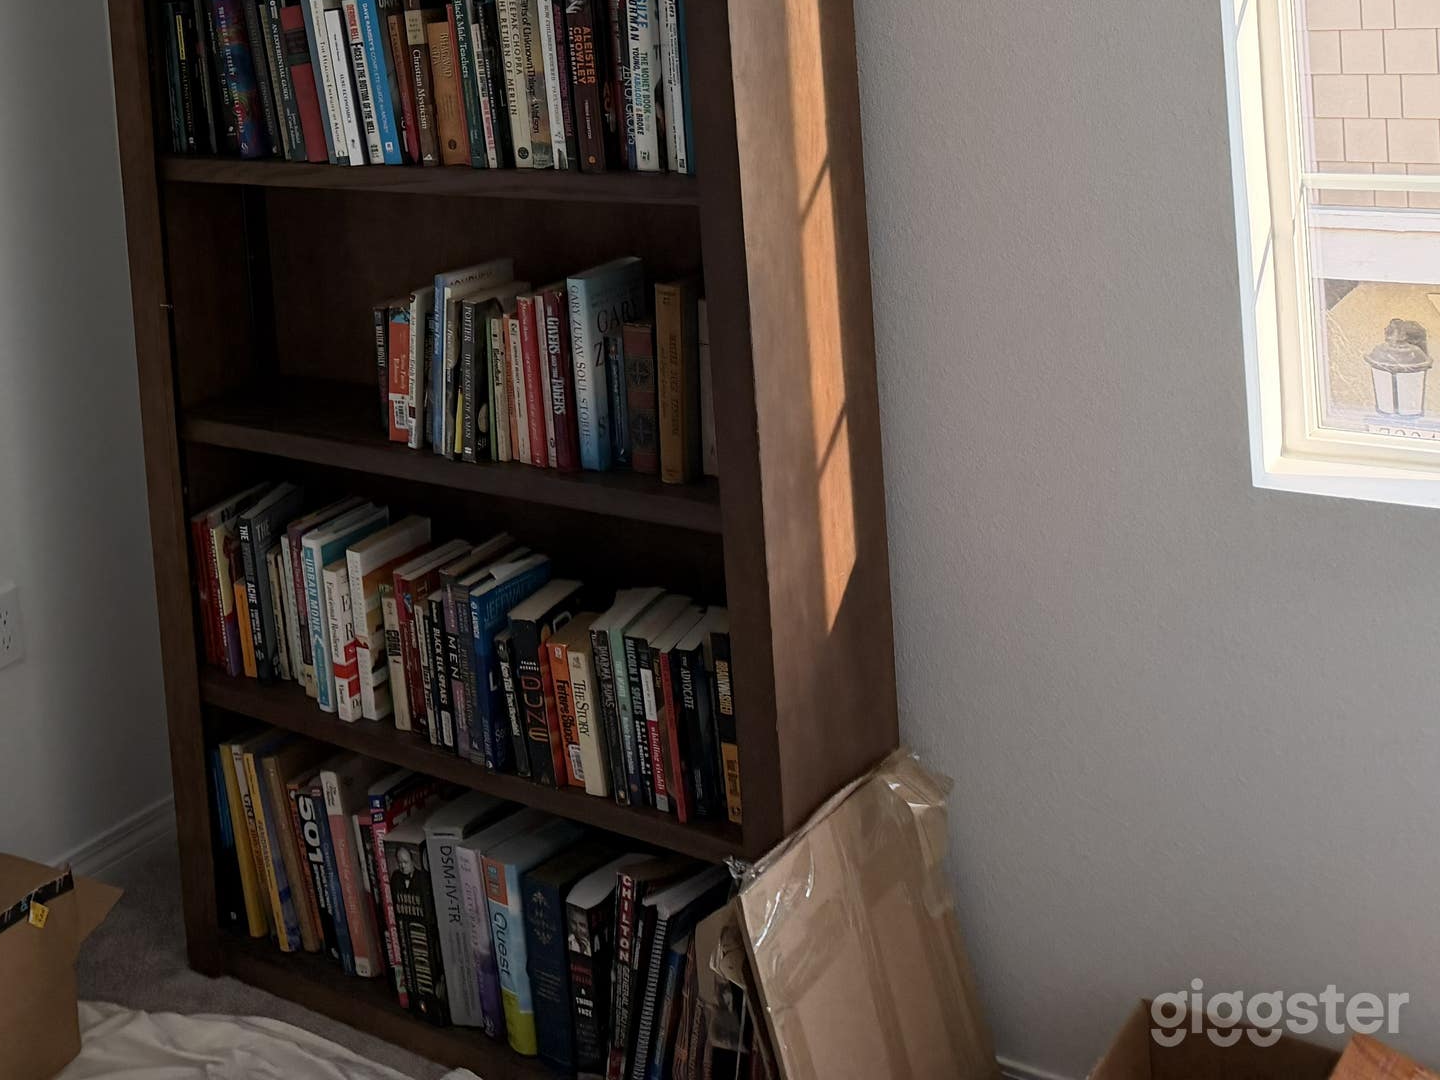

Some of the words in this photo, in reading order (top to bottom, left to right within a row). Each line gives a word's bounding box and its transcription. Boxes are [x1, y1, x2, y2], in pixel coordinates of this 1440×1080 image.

[346, 4, 357, 26] DERRICK
[456, 21, 466, 41] Male
[628, 0, 640, 42] ORMAN
[350, 28, 359, 40] BELL
[500, 18, 509, 57] RETURN
[522, 27, 534, 69] Unknown
[272, 34, 286, 78] EXPERIENTIAL
[412, 49, 422, 86] Christian
[459, 43, 470, 79] Teachers
[505, 61, 513, 75] OF
[511, 34, 522, 75] CHOPRA
[573, 26, 587, 85] CROWLEY
[581, 26, 596, 84] ALEISTER
[631, 47, 641, 72] YOUNG,
[640, 52, 648, 66] THE
[357, 69, 365, 79] THE
[633, 73, 643, 107] FABULOUS
[641, 67, 650, 93] MONEY
[364, 110, 372, 119] THE
[415, 88, 429, 129] Mysticism
[507, 79, 518, 116] MERLIN
[643, 94, 652, 114] BOOK
[367, 121, 375, 135] WELL
[636, 113, 644, 136] BROKE
[569, 285, 581, 315] GARY
[463, 306, 473, 343] POITIER
[546, 317, 561, 354] GIVERS
[572, 320, 584, 358] ZUKAV
[576, 362, 588, 392] SOUL
[551, 378, 567, 416] TAKERS
[464, 420, 472, 439] MAN
[581, 398, 592, 450] STORIES
[239, 525, 249, 542] THE
[247, 582, 258, 606] ACHE
[305, 559, 316, 598] URBAN
[310, 600, 321, 633] MONK
[432, 627, 443, 655] BLACK
[447, 635, 460, 680] MEN
[435, 656, 445, 672] ELK
[598, 645, 611, 681] DHARMA
[625, 639, 637, 674] MALCOLM
[631, 686, 644, 715] SPEAKS
[437, 673, 448, 705] SPEAKS
[555, 679, 570, 714] Future
[573, 680, 586, 701] THE
[680, 668, 695, 711] ADVOCATE
[715, 659, 733, 715] BRAINWASHED
[575, 701, 590, 737] STORY
[242, 793, 256, 825] GRE
[298, 795, 323, 867] 501
[440, 845, 461, 924] DSM-IV-TR
[618, 875, 633, 963] CHILTON
[409, 922, 434, 997] CHURCHILL
[492, 912, 510, 975] Quest
